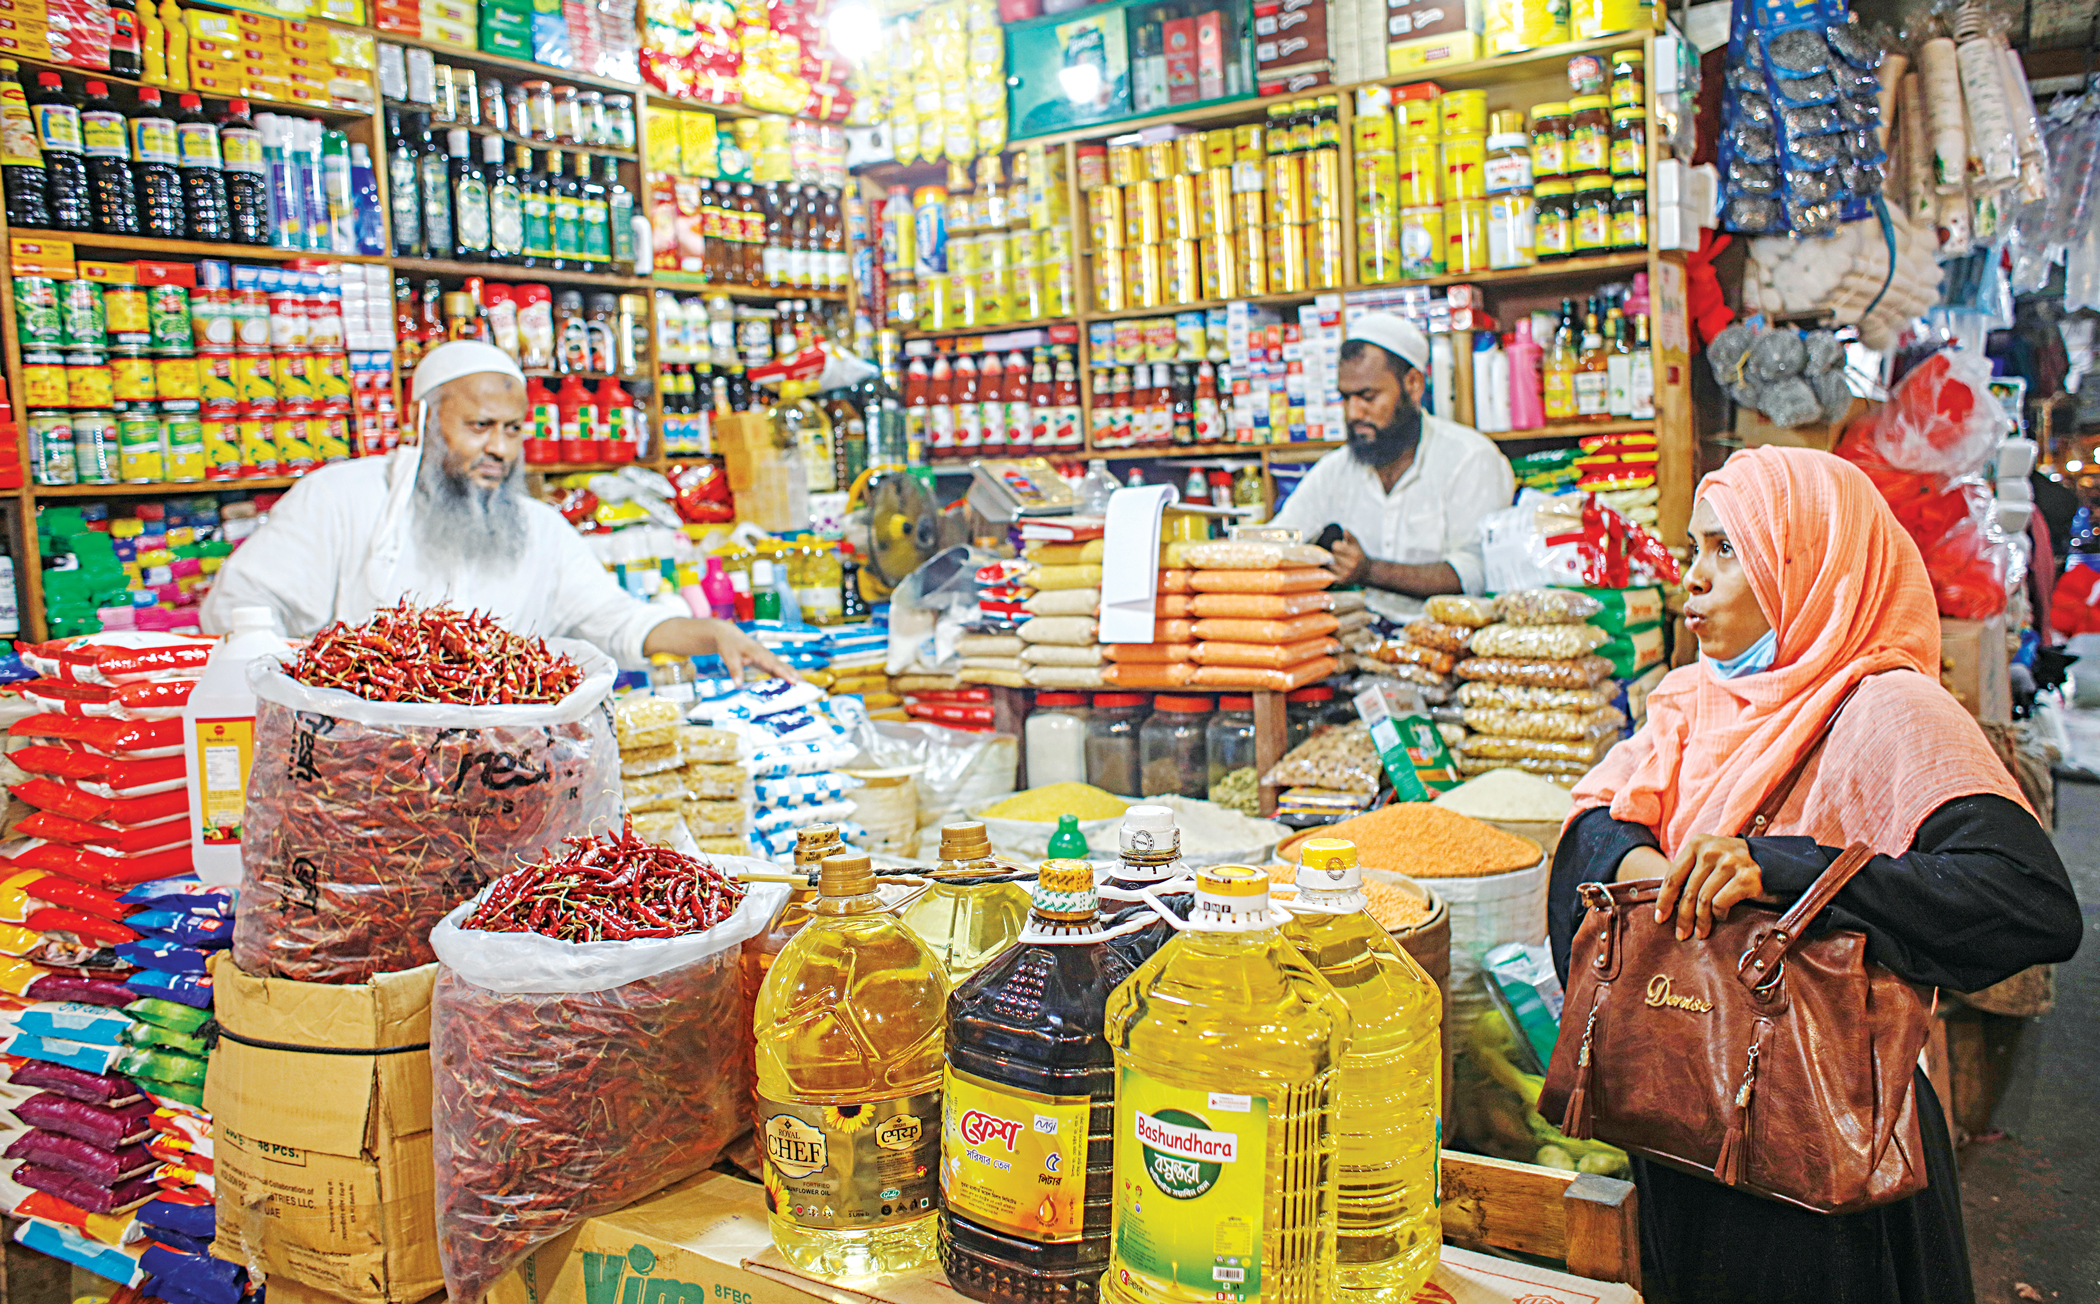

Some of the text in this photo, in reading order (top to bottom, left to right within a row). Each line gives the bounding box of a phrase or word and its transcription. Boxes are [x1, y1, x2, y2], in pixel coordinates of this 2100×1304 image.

[1644, 973, 1714, 1013] Denise
[778, 1128, 801, 1140] ROYAL
[1138, 1115, 1232, 1157] Bashundhara
[272, 1144, 300, 1159] PCS.
[768, 1133, 823, 1164] CHEF
[965, 1148, 1012, 1173] সরিষার তেল
[1154, 1152, 1200, 1187] বসুন্ধরা
[269, 1179, 306, 1195] Collaboration
[802, 1181, 831, 1189] FORTIFIED
[1038, 1173, 1063, 1187] লিটার
[786, 1185, 819, 1196] SUNFLOWER
[297, 1197, 317, 1210] LLC.
[264, 1206, 281, 1219] UAE
